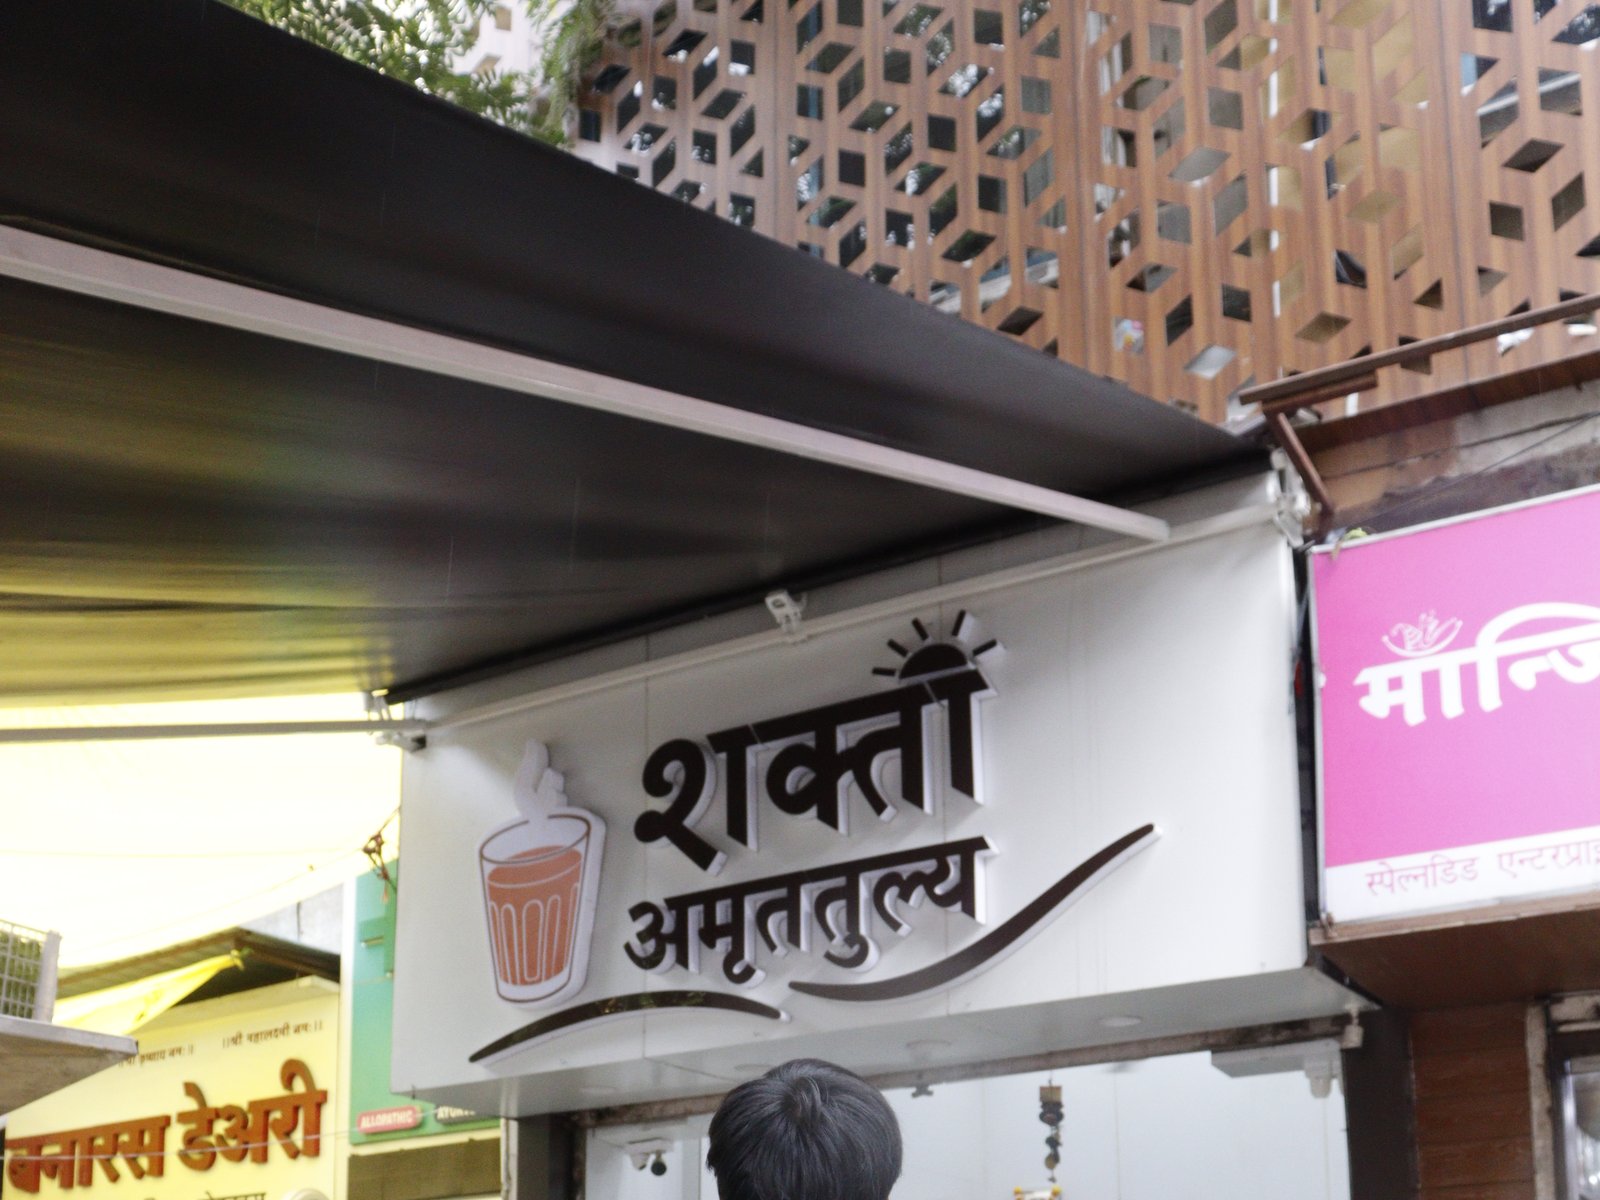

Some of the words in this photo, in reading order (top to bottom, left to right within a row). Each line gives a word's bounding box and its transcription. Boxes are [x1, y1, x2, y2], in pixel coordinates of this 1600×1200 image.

[624, 836, 1000, 987] अमृततुल्य
[5, 1115, 171, 1194] बनारस
[176, 1059, 328, 1172] डेअरी
